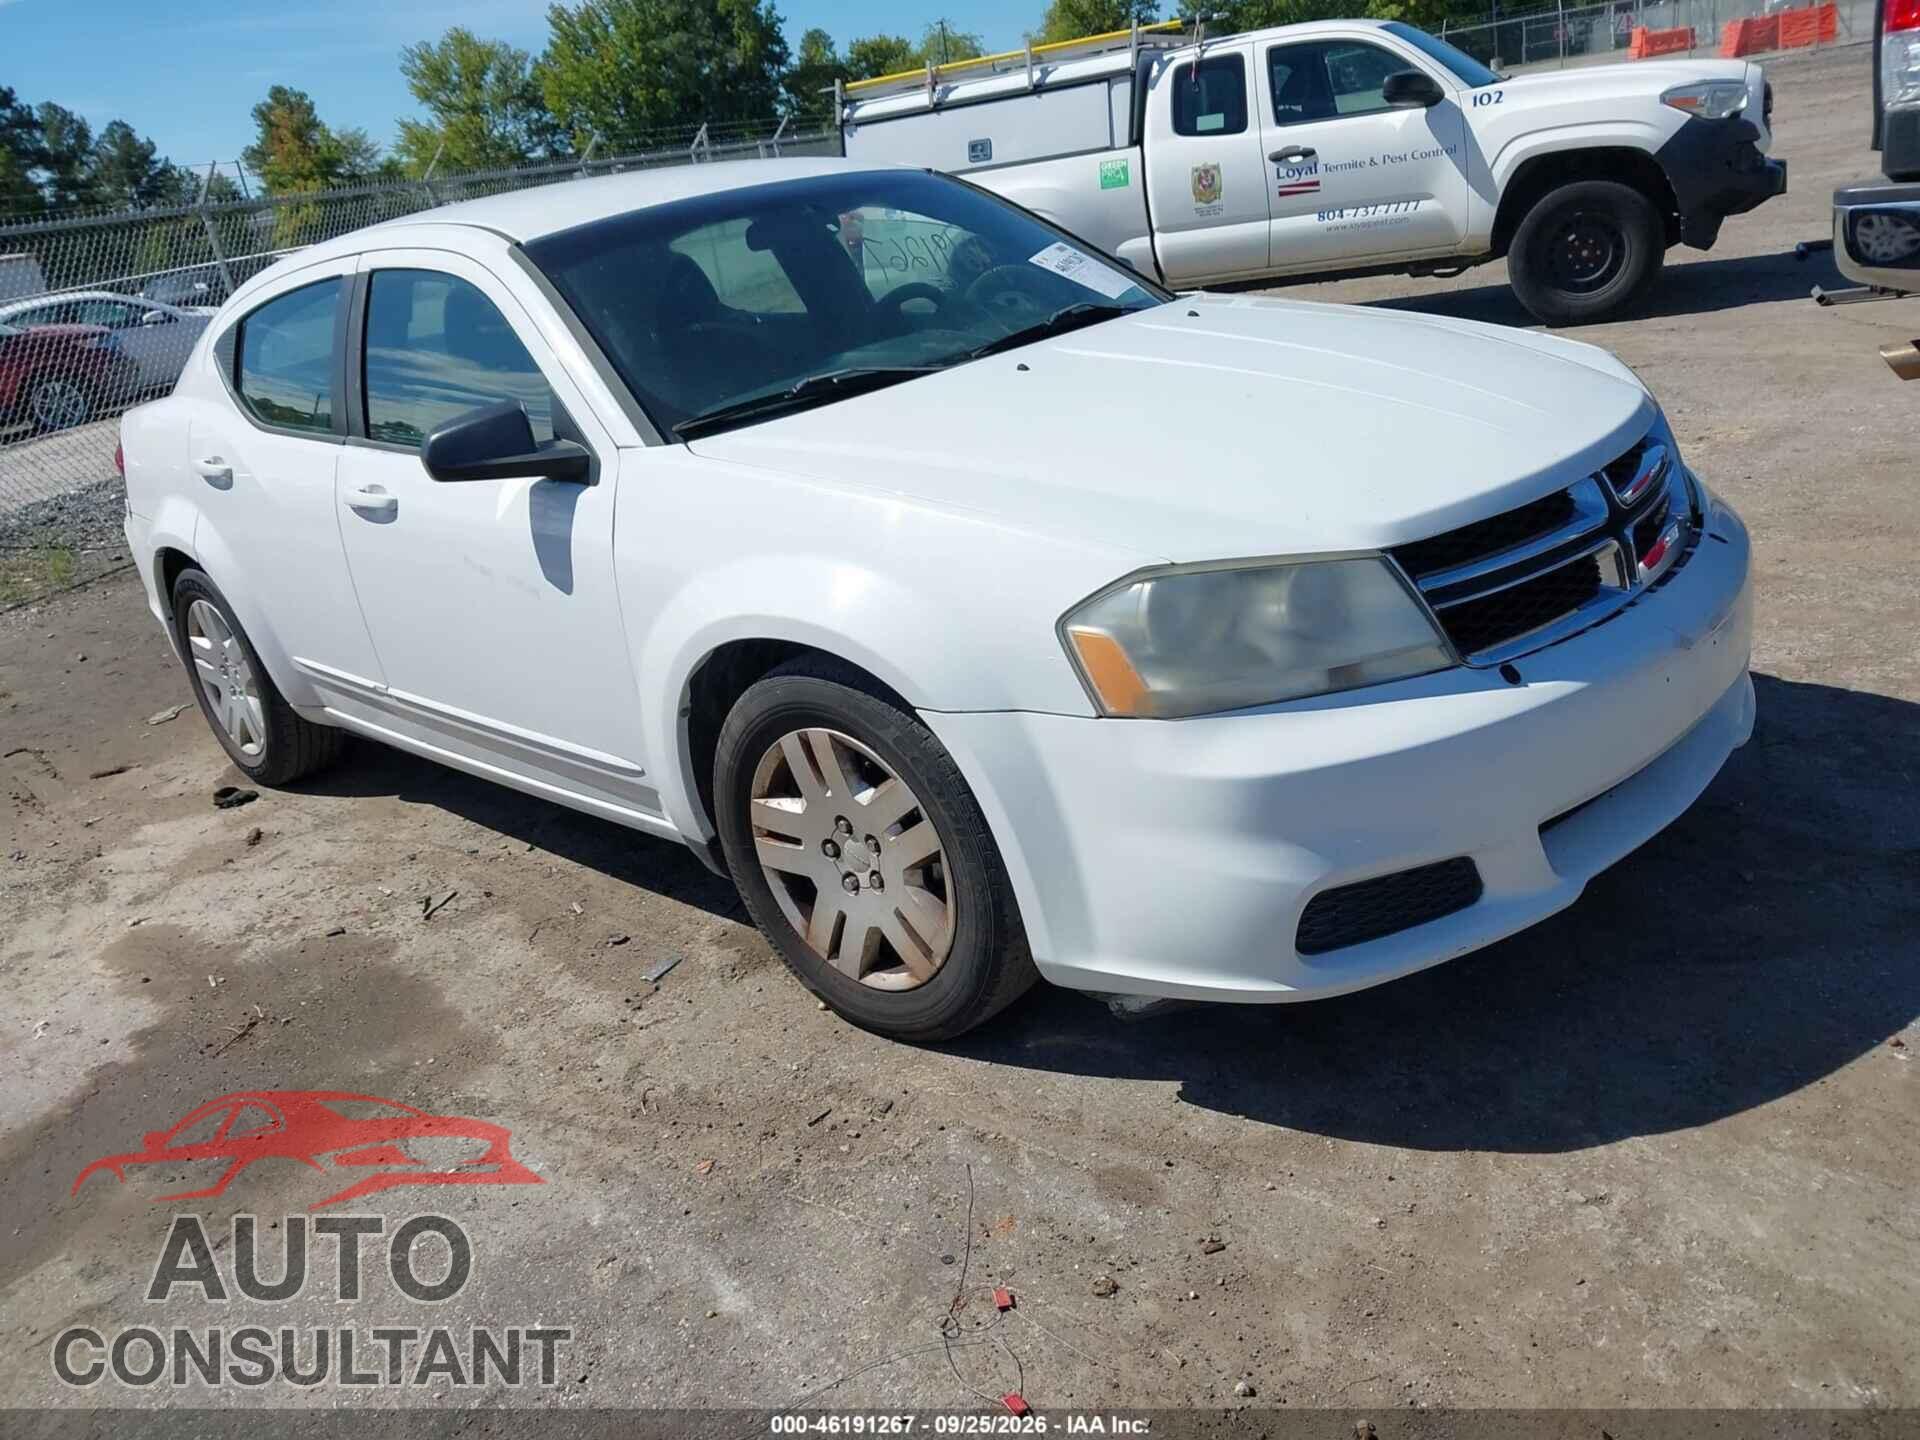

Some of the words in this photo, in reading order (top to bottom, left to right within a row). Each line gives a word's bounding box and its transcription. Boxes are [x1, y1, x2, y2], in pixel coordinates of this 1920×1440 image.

[1473, 90, 1504, 108] 102
[1276, 163, 1318, 182] Loyal
[1322, 160, 1366, 174] Termite
[1369, 156, 1379, 167] &
[1382, 152, 1408, 165] Pest
[1411, 144, 1457, 161] Control
[1318, 200, 1420, 222] 804-737-7777
